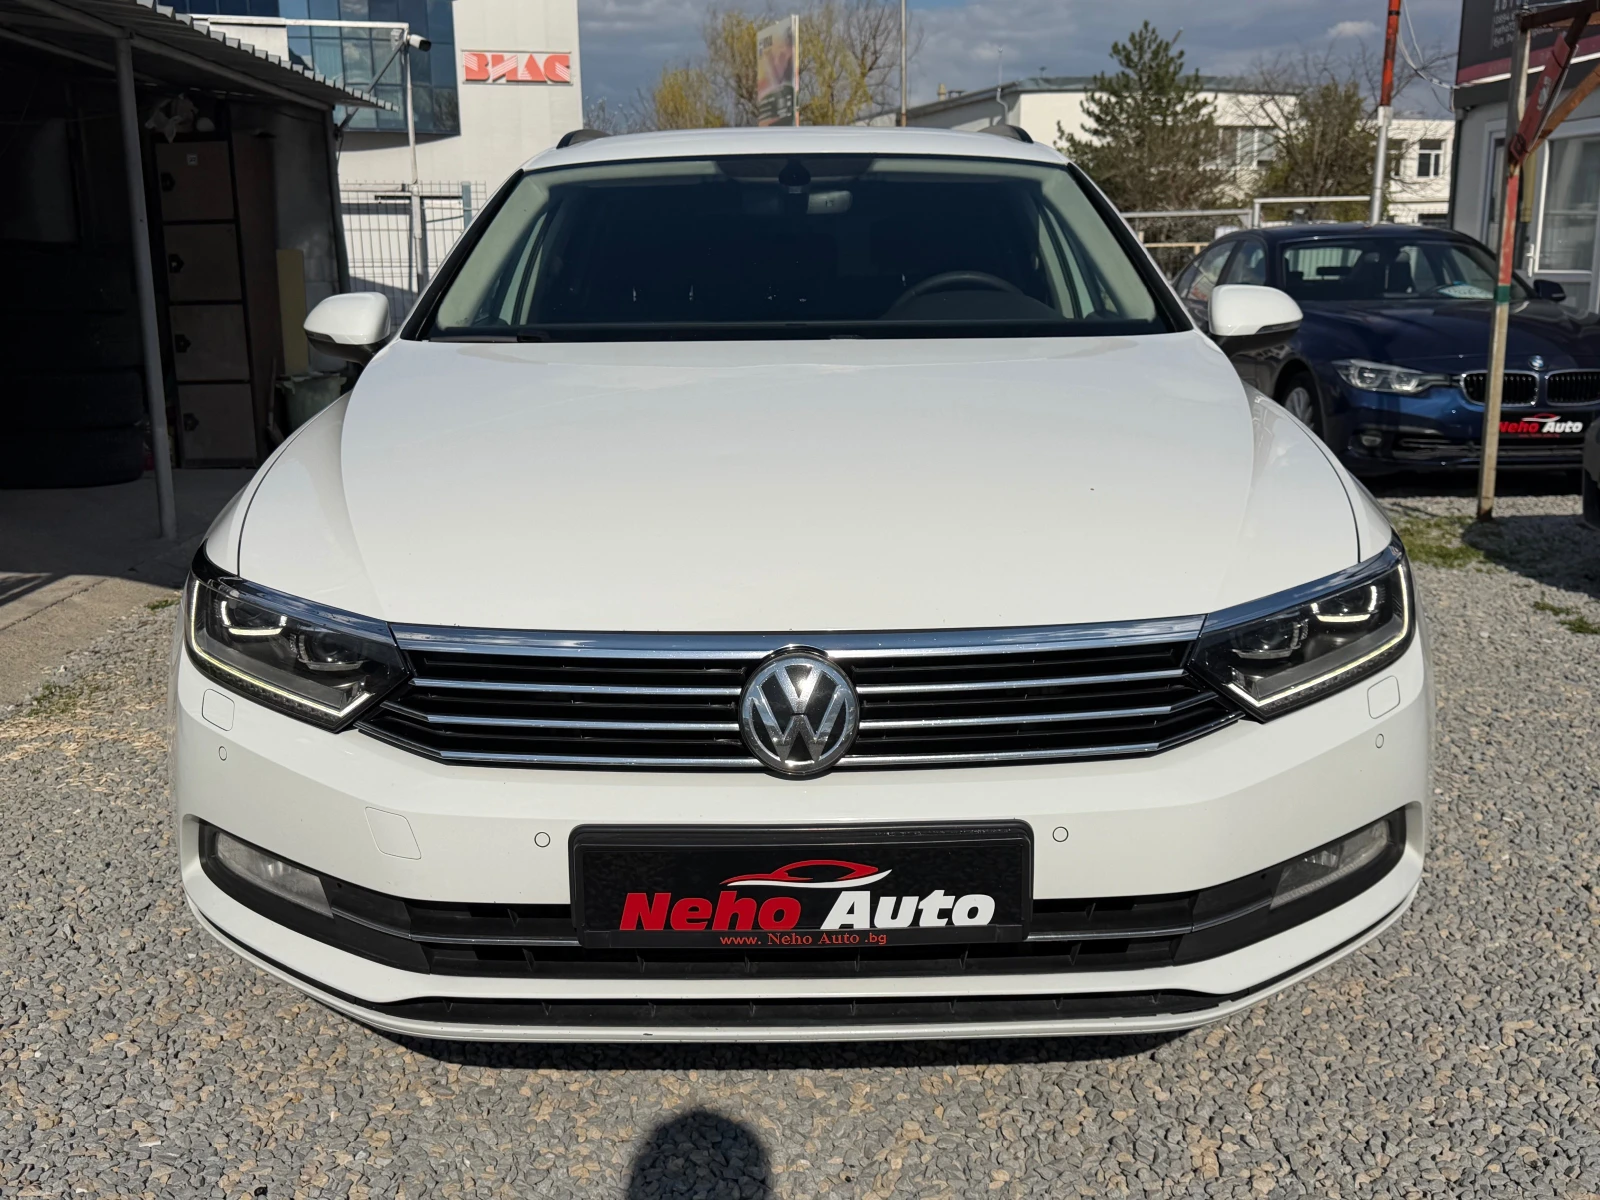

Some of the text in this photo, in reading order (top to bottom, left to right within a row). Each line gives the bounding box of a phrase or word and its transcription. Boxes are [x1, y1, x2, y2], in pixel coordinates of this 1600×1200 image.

[1499, 421, 1583, 433] Neho Auto
[619, 889, 996, 931] Neho Auto
[719, 932, 887, 945] www. Neho Auto .bg
